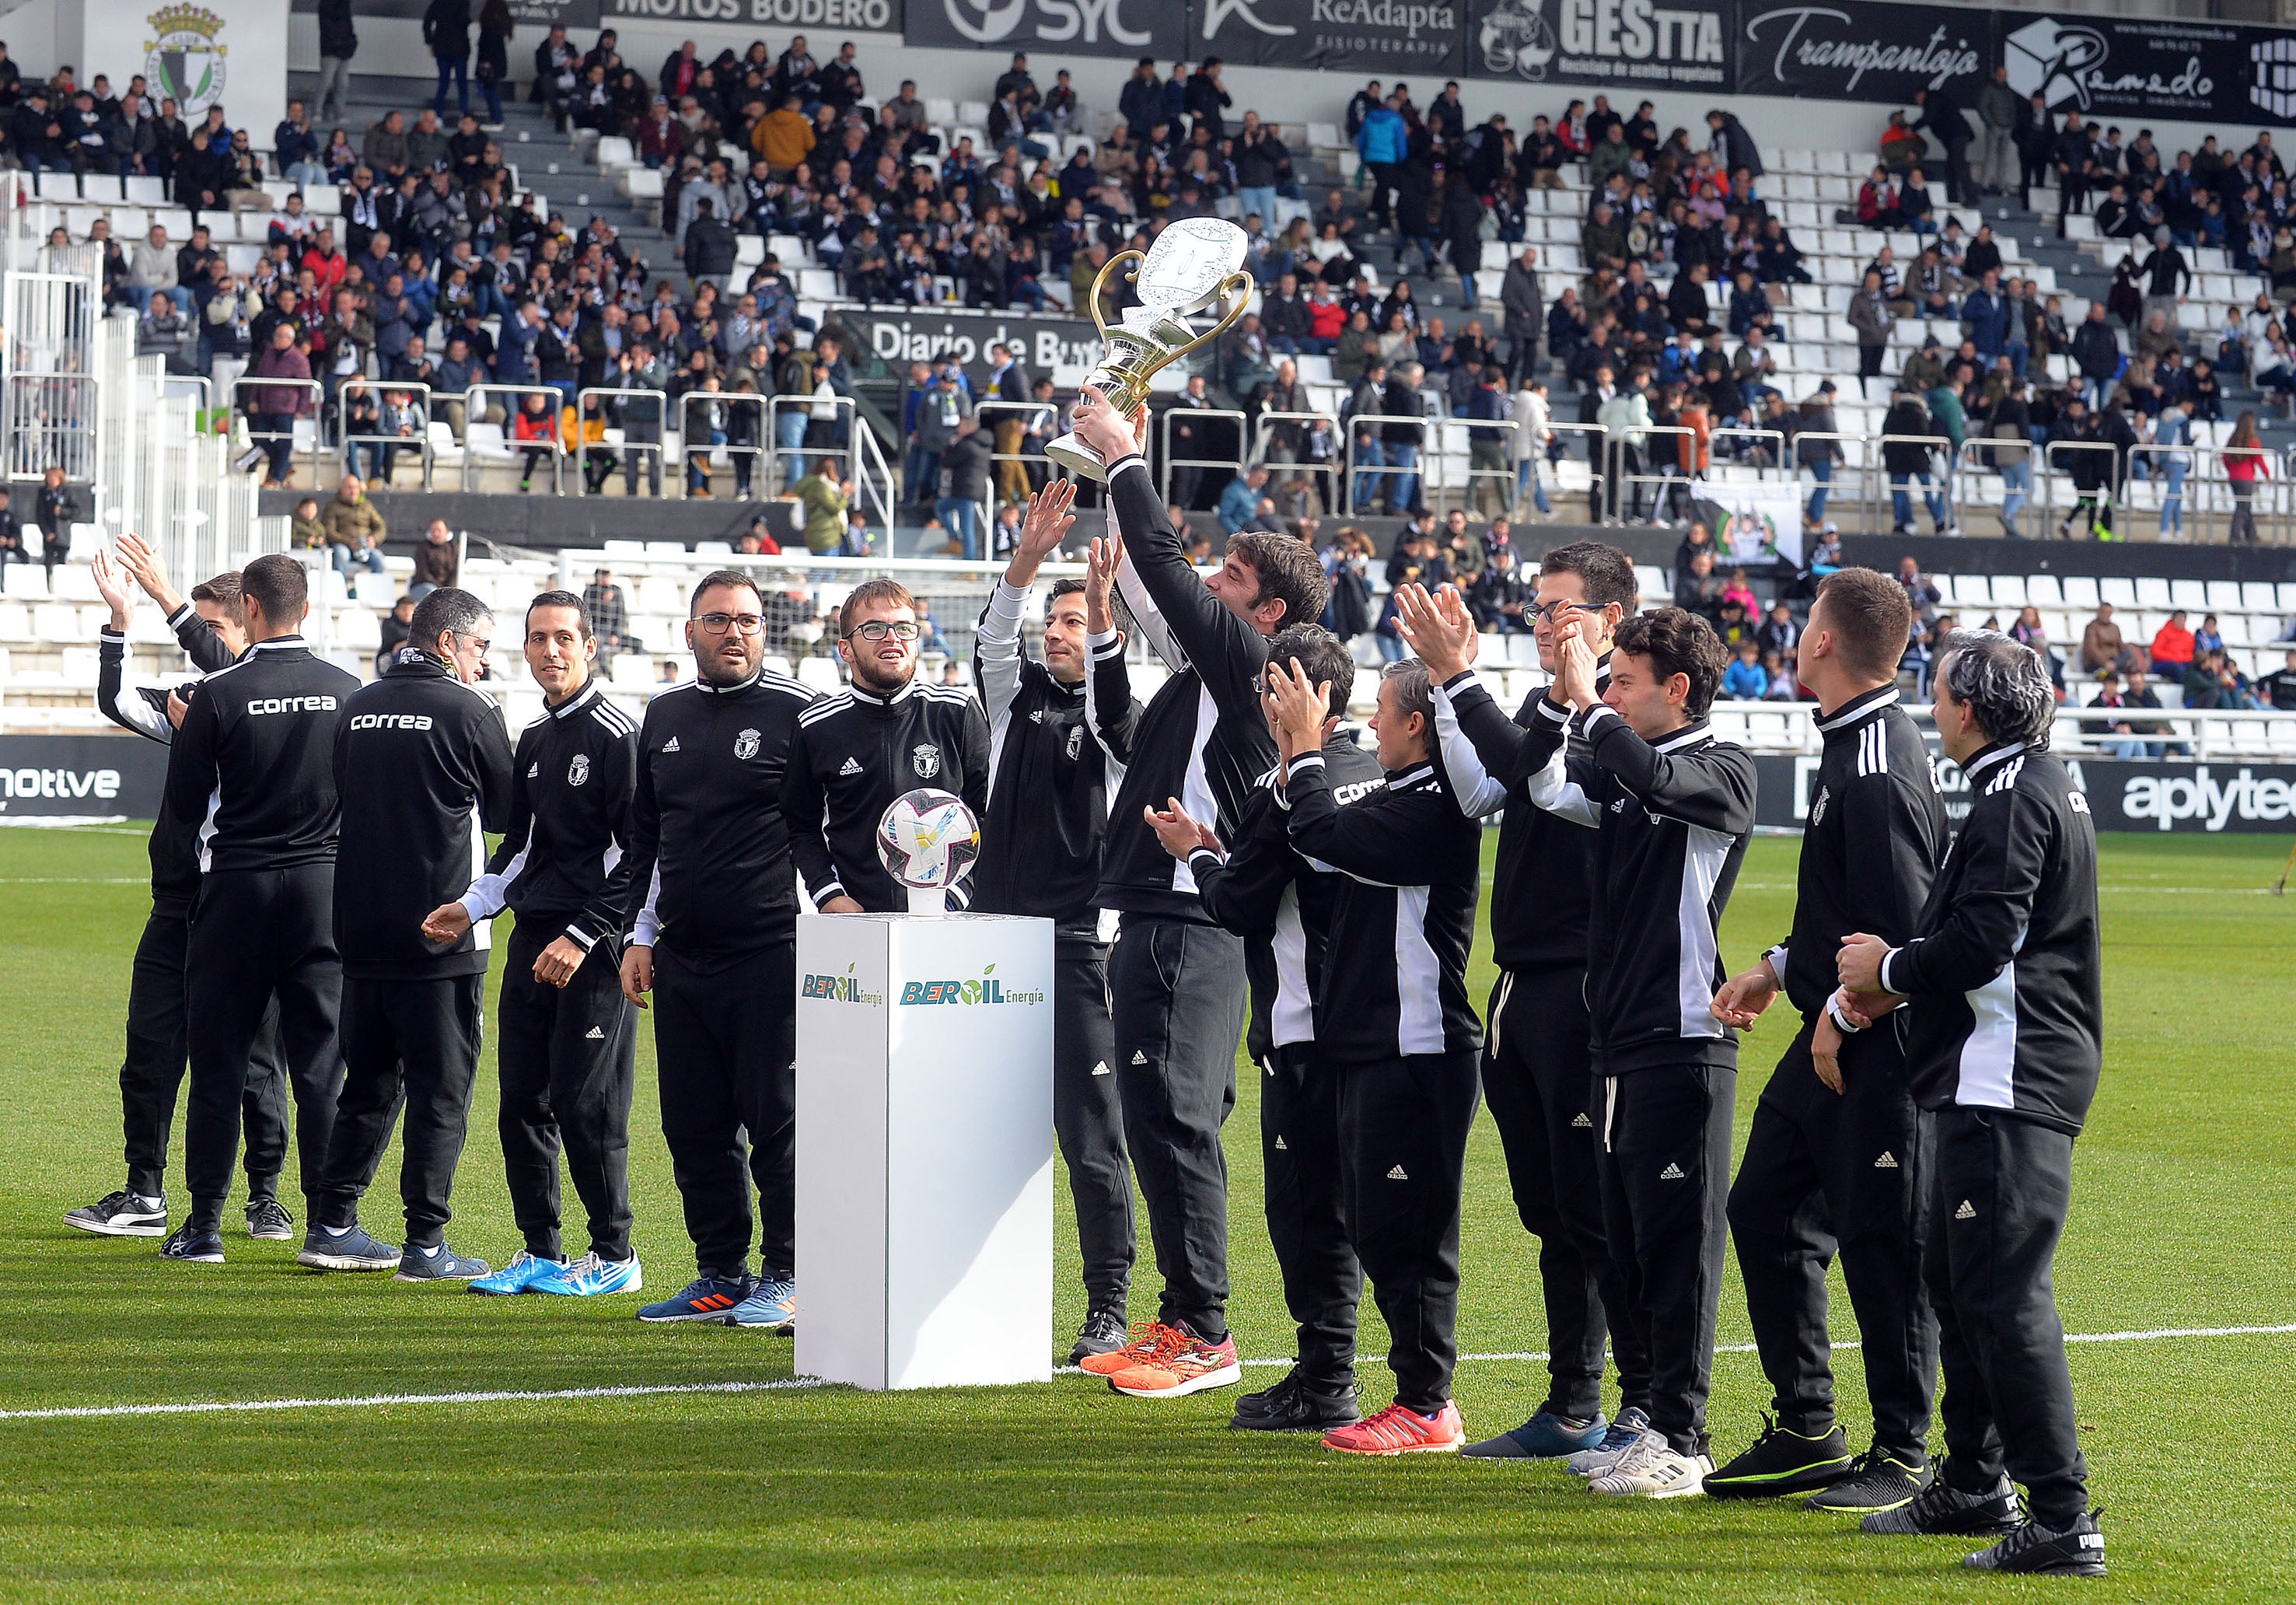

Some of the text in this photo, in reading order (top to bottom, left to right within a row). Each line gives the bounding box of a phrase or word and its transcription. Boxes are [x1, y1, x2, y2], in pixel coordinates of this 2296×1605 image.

[751, 0, 891, 28] BODERO
[1311, 0, 1457, 38] ReAdapta
[872, 320, 977, 365] Diario
[983, 323, 1027, 366] de
[247, 695, 337, 716] correa
[350, 713, 434, 732] correa
[2122, 765, 2296, 832] aplyte
[1005, 988, 1045, 1010] Energía
